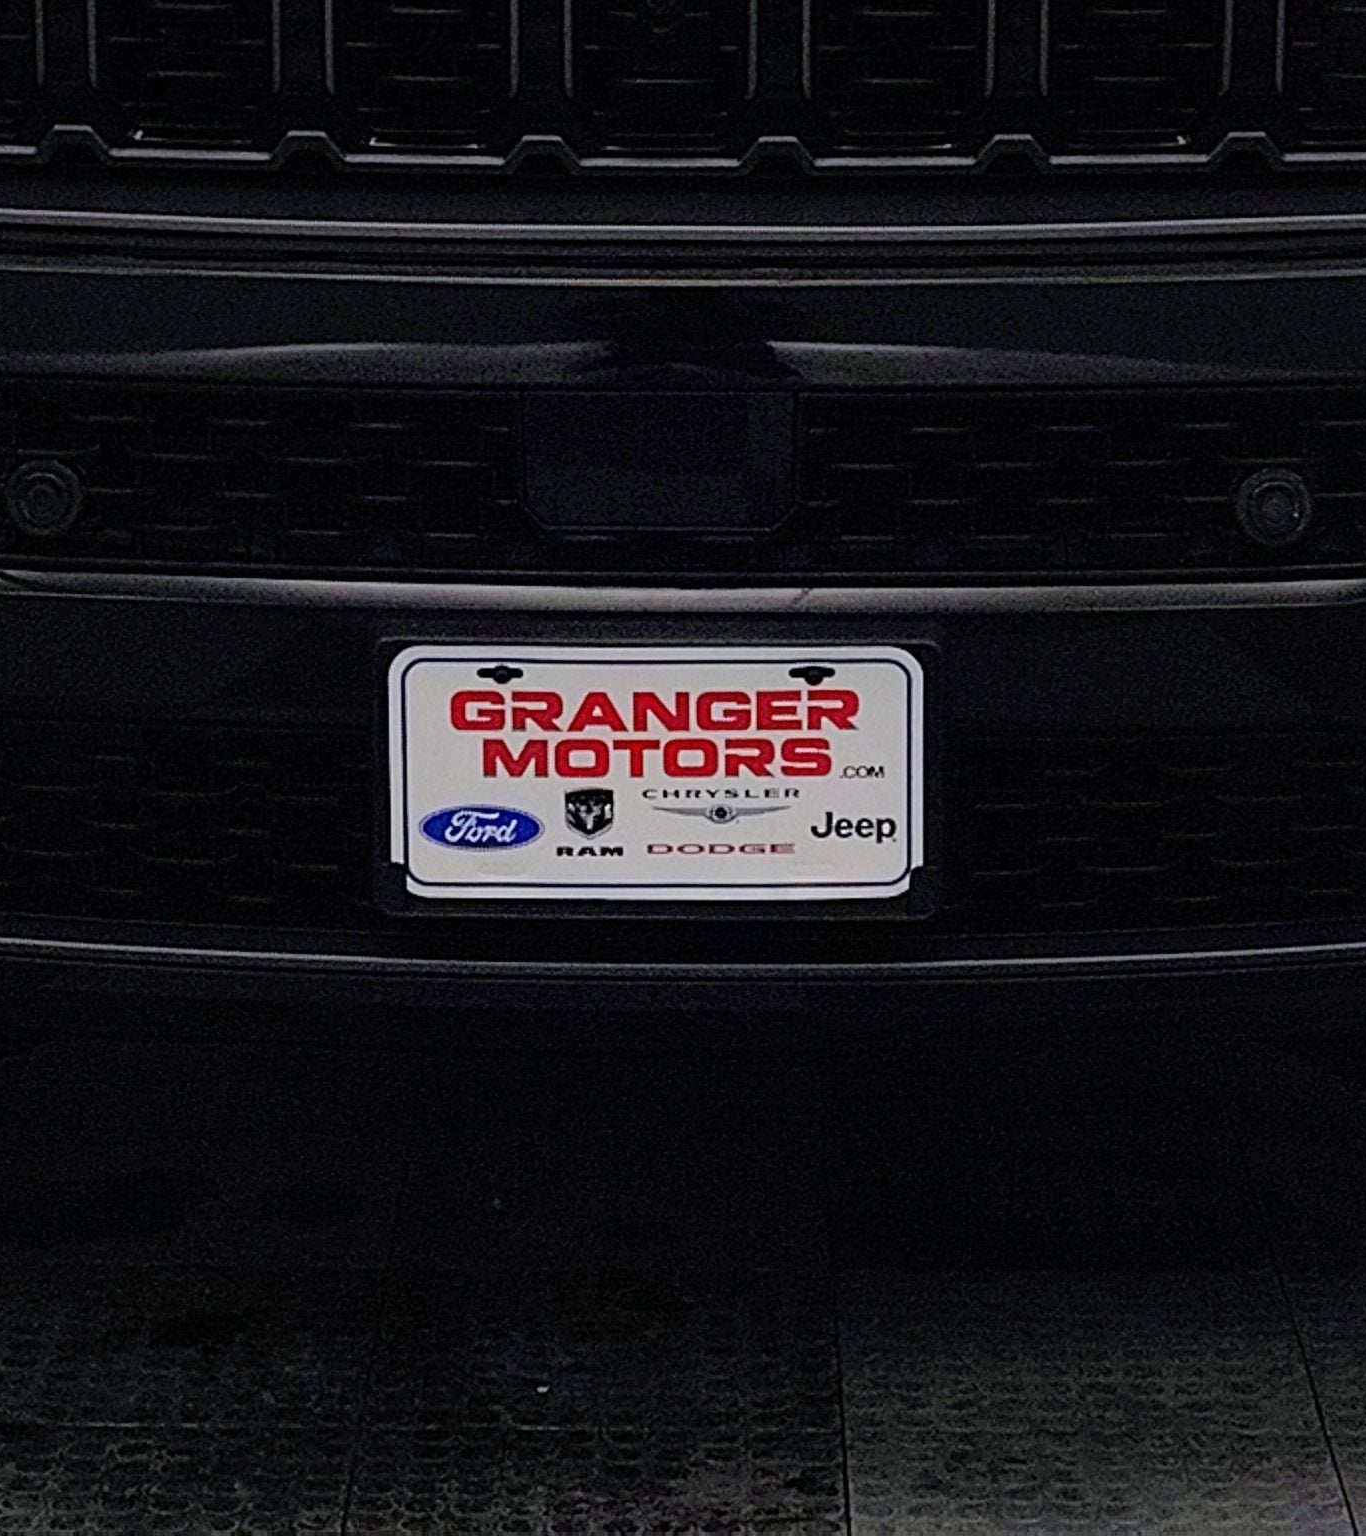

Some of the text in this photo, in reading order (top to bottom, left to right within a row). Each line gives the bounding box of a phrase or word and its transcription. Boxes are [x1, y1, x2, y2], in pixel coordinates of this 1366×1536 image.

[449, 689, 860, 732] GRANGER
[482, 737, 833, 779] MOTORS
[641, 788, 801, 799] CHRYSLER
[444, 811, 517, 843] Ford
[810, 811, 897, 844] Jeep
[556, 846, 624, 858] RAM
[646, 843, 796, 855] DODGE
